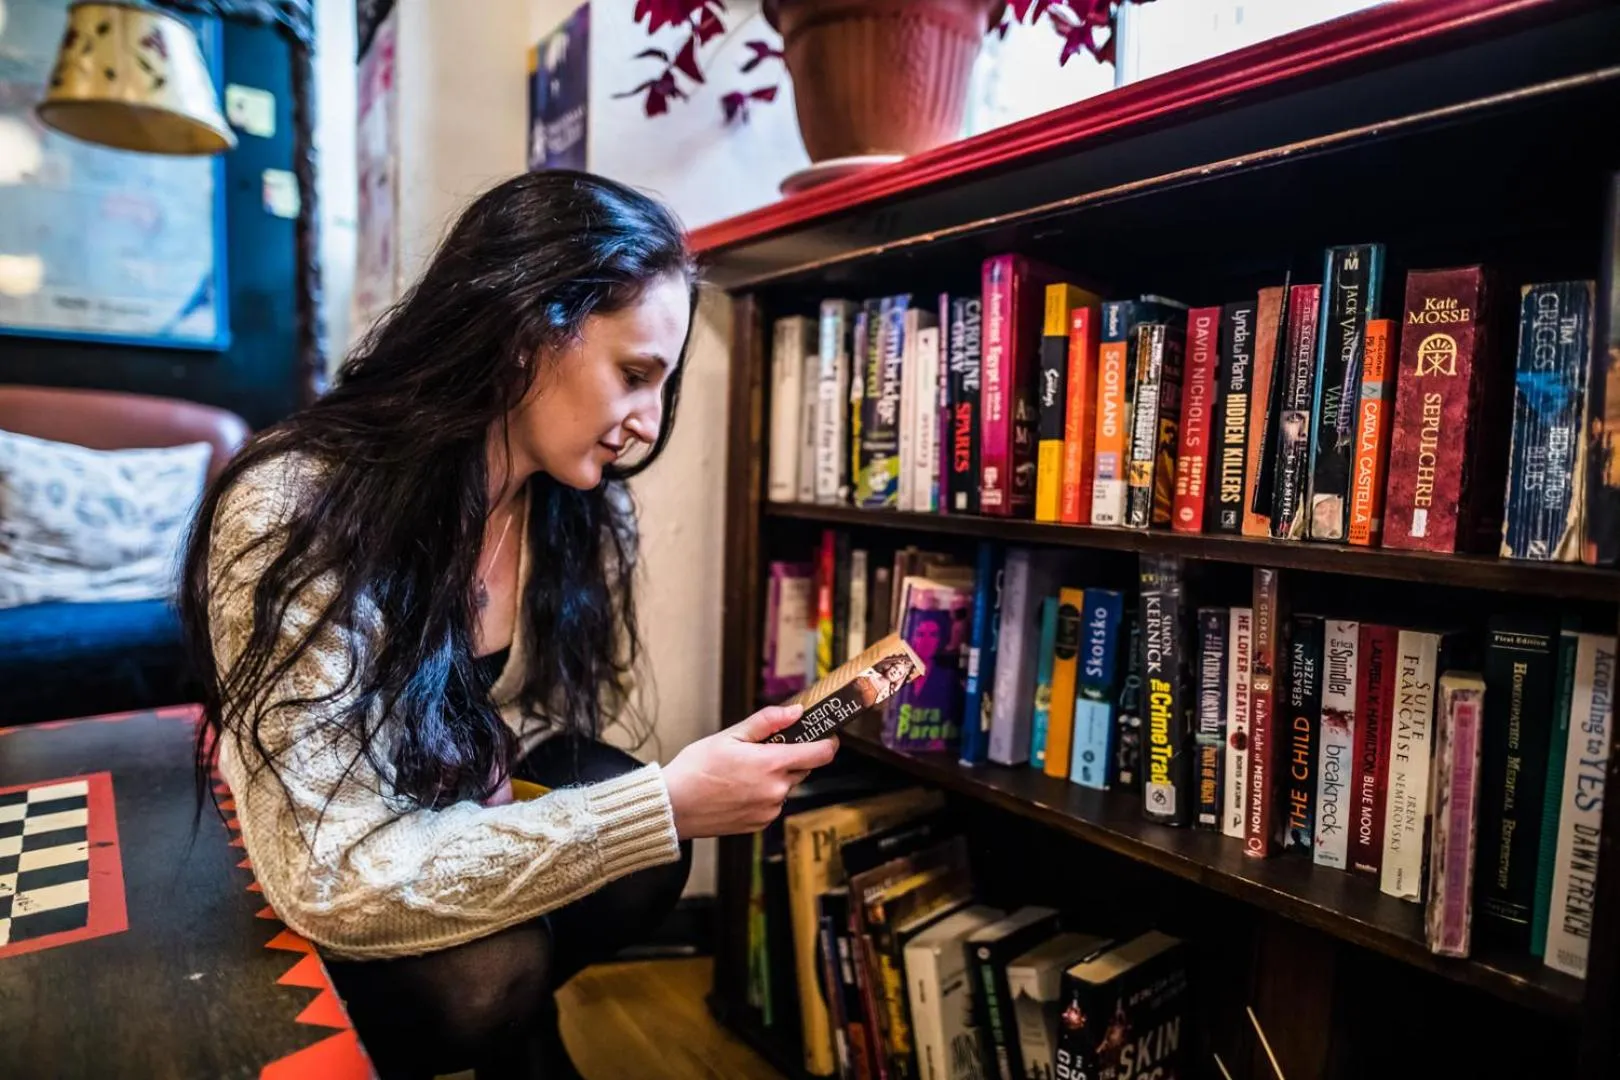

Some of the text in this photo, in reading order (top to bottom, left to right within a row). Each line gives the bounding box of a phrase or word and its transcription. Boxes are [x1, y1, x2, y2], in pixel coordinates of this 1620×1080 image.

[990, 291, 1005, 343] Ancient
[1340, 284, 1359, 315] JACK
[1408, 308, 1470, 325] MOSSE
[1424, 297, 1459, 311] Kate
[963, 299, 981, 392] CAROLINE
[1232, 308, 1251, 342] Lynda
[1299, 324, 1312, 366] SECRET
[1340, 315, 1357, 362] VANCE
[1533, 291, 1559, 370] GRIGGS
[1559, 315, 1578, 346] TIM
[1102, 350, 1120, 437] SCOTLAND
[1186, 316, 1211, 447] DAVID NICHOLLS
[1231, 353, 1250, 391] Plante
[1295, 367, 1308, 410] CIRCLE
[1224, 393, 1247, 443] HIDDEN
[1323, 386, 1341, 428] VAART
[954, 400, 972, 473] SPARES
[1414, 392, 1442, 509] SEPULCHRE
[1176, 456, 1189, 496] for ten
[1190, 455, 1203, 497] starter
[1220, 447, 1244, 503] KILLERS
[1524, 446, 1545, 492] BLUES
[1544, 426, 1569, 510] REDEMPTION
[1281, 481, 1294, 516] SMITH
[1086, 606, 1107, 678] Skotsko
[1146, 597, 1162, 673] KERNICK
[1161, 614, 1173, 656] SIMON
[1237, 614, 1249, 631] HE
[1258, 603, 1268, 646] GEORGE
[1330, 638, 1353, 650] Erica
[1494, 634, 1548, 648] First Edition
[1202, 651, 1222, 688] PATRICIA
[1236, 635, 1248, 673] LOVER
[1291, 643, 1304, 707] SEBASTIAN
[1303, 657, 1314, 696] FITZEK
[1328, 649, 1353, 698] Spindler
[1369, 639, 1383, 692] LAURELL
[801, 697, 843, 728] QUEEN
[835, 698, 862, 723] THE
[898, 703, 941, 723] Sara
[1199, 689, 1221, 739] CORNWELL
[1234, 682, 1247, 724] DEATH
[1411, 680, 1431, 741] SUITE
[795, 713, 840, 744] WHITE
[1150, 692, 1173, 785] Crime Trad
[1253, 728, 1264, 751] Light
[1363, 707, 1379, 775] HAMILTON
[1574, 648, 1616, 813] According to YES
[1234, 755, 1243, 778] BORIS
[1289, 716, 1310, 830] THE CHILD
[1321, 744, 1346, 836] breakneck
[1503, 754, 1522, 811] MEDICAL
[1250, 765, 1262, 834] MEDITATION
[1359, 775, 1375, 846] BLUE MOON
[1571, 822, 1600, 870] DAWN
[1562, 866, 1597, 940] FRENCH
[1119, 1016, 1179, 1080] SKIN
